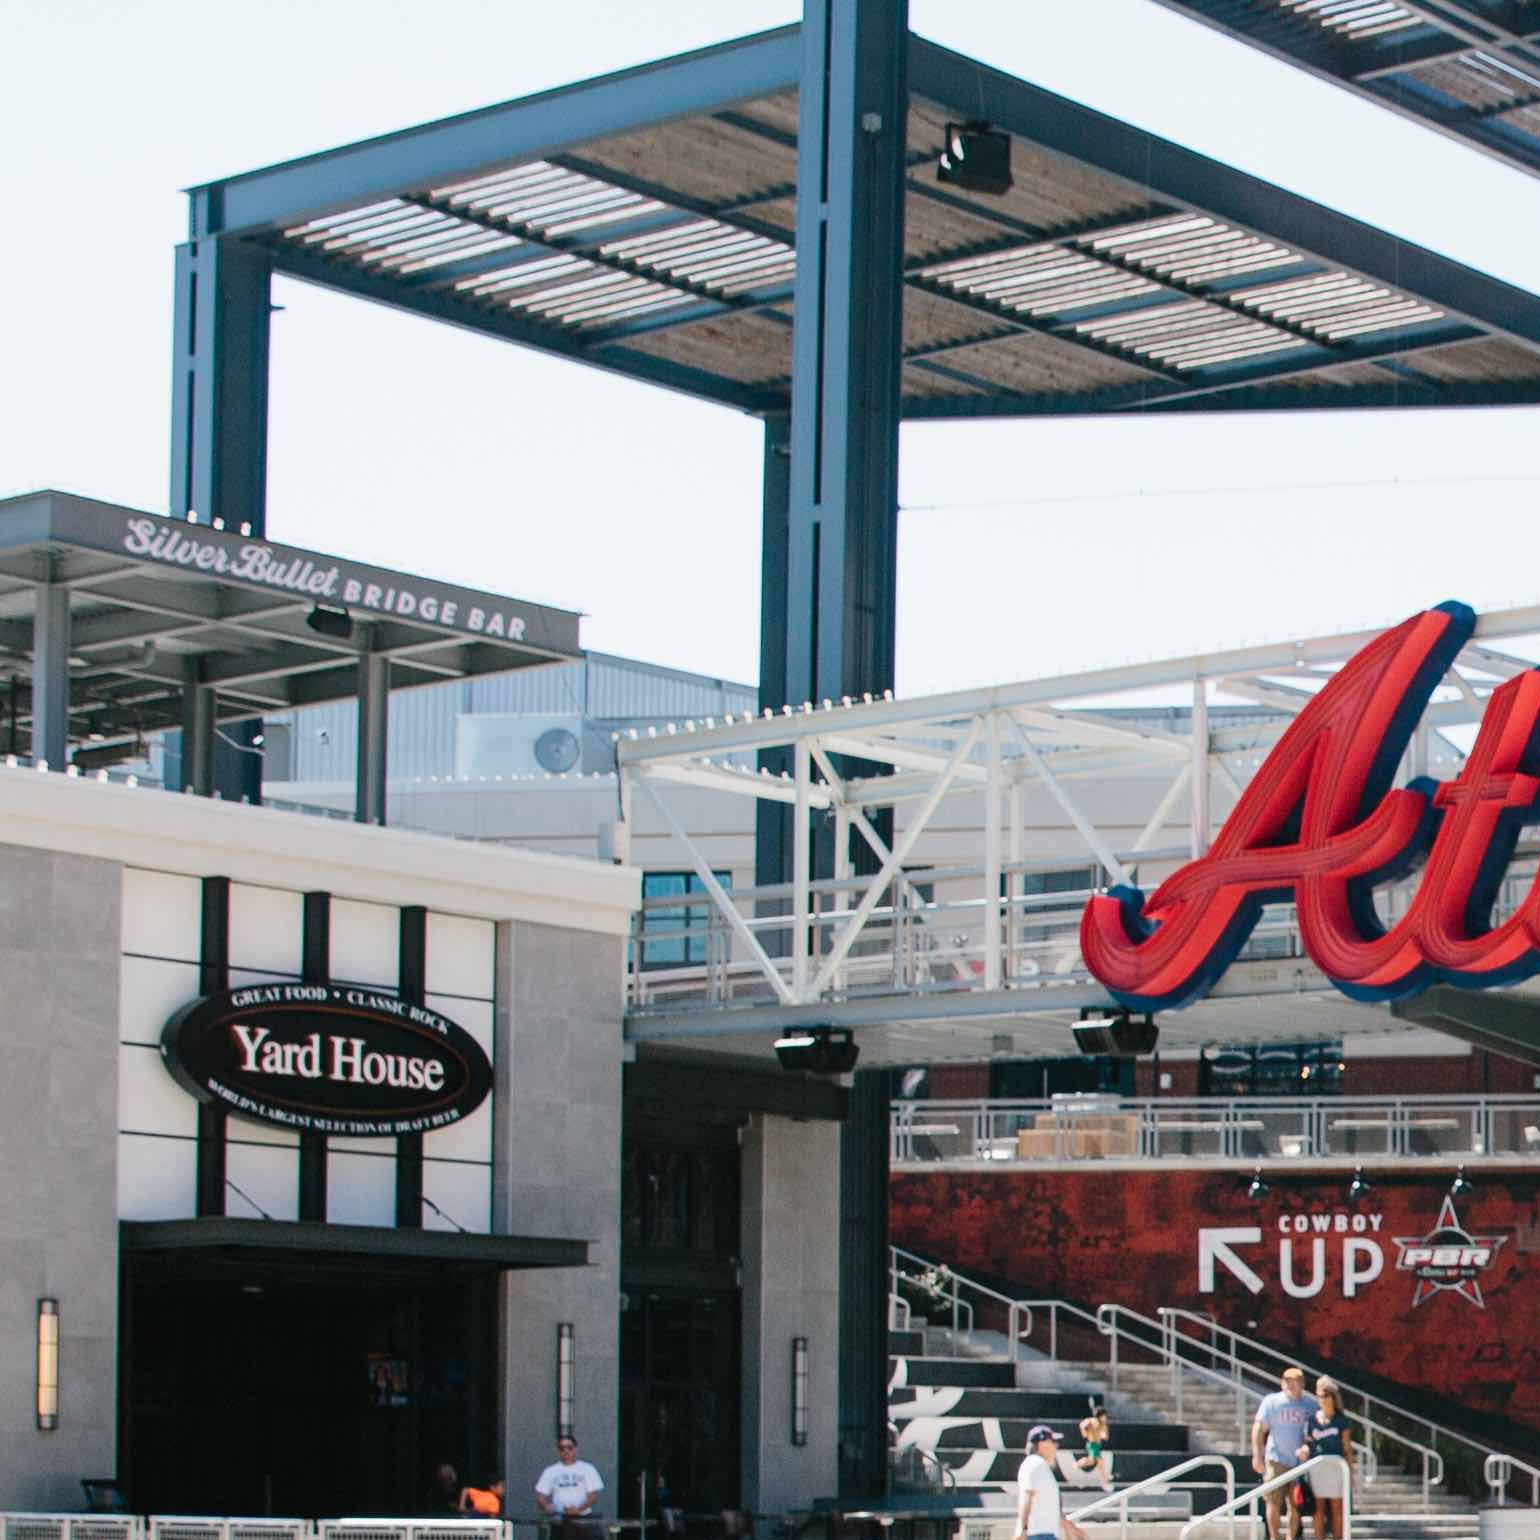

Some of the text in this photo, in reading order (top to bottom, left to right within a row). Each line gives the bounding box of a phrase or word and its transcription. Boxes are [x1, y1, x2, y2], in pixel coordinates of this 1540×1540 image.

[124, 518, 527, 641] Silver Bullet BRIDGE BAR
[231, 986, 449, 1035] GREAT FOOD CLASSIC ROCK
[231, 1023, 445, 1092] Yard House
[1278, 1213, 1384, 1234] COWBOY
[1279, 1236, 1385, 1299] UP
[1403, 1248, 1491, 1267] PBR
